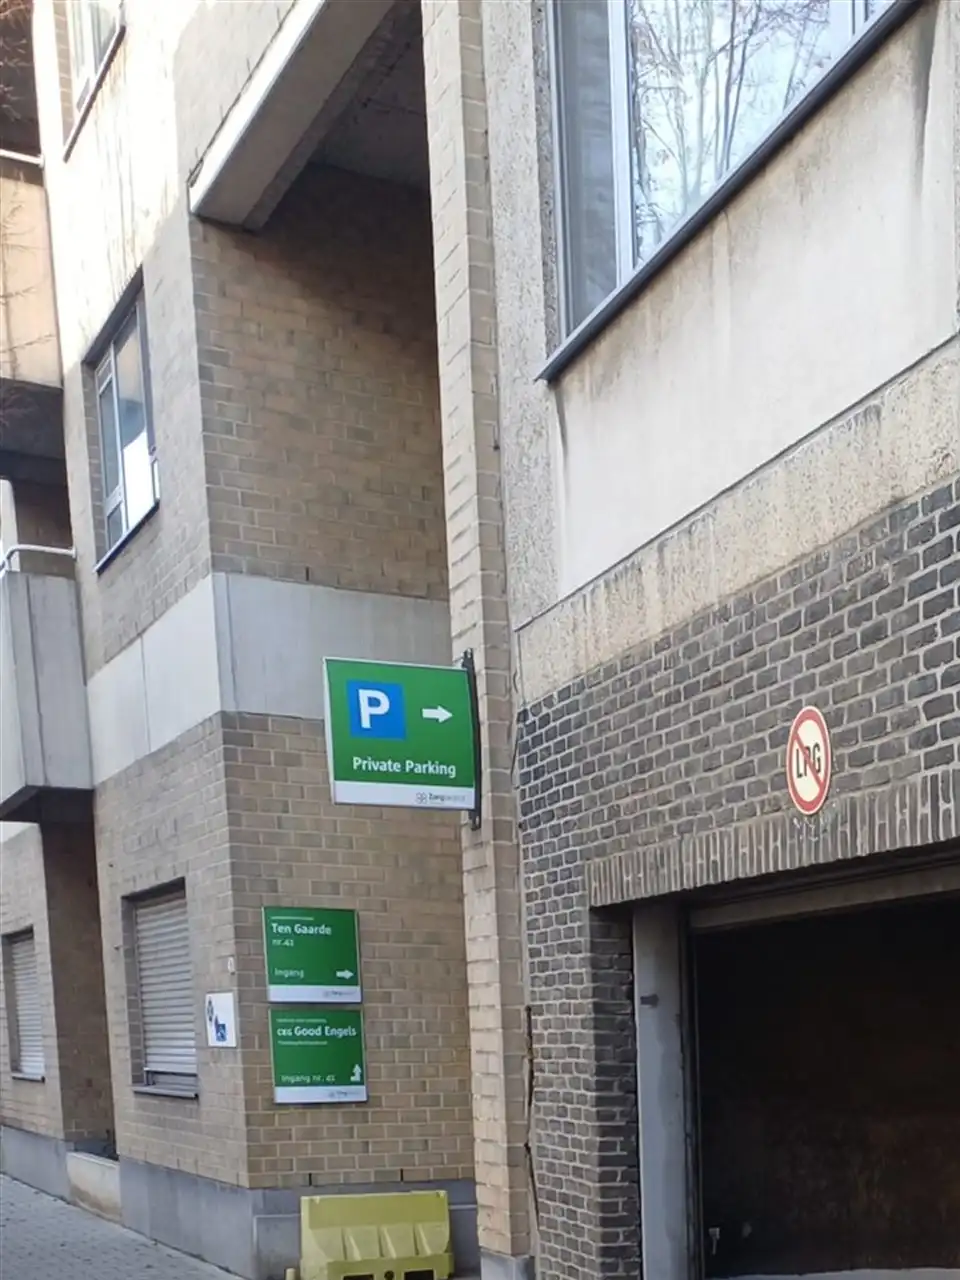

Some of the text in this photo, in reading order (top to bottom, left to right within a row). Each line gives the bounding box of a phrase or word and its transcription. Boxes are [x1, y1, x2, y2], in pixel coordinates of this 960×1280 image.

[358, 689, 391, 729] P
[352, 756, 457, 778] Private Parking
[796, 742, 822, 779] LPG
[271, 923, 332, 935] Ten Gaarde
[294, 1025, 322, 1036] Good
[324, 1025, 357, 1038] Engels
